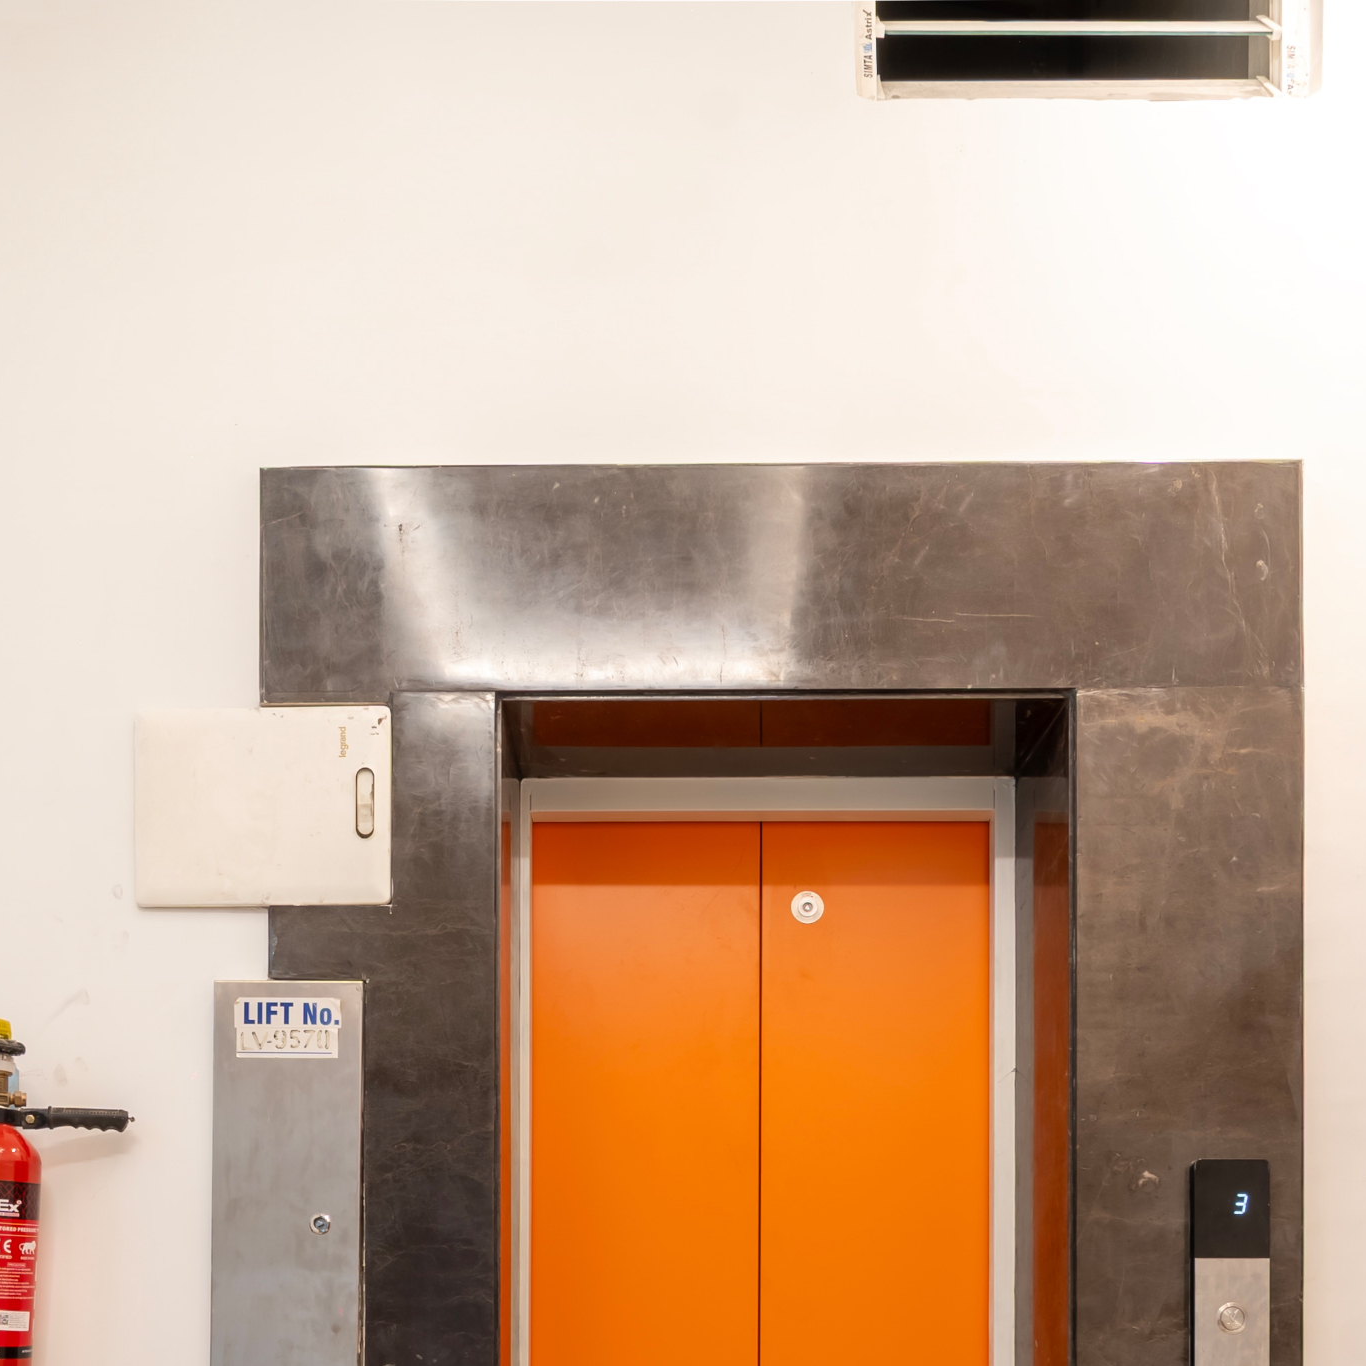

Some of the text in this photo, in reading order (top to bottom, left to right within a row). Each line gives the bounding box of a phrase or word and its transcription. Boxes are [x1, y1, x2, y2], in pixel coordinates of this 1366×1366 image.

[862, 9, 873, 78] SIMTA Astrix
[338, 726, 349, 758] legrand
[243, 1001, 340, 1026] LIFT No.
[1233, 1193, 1249, 1215] 3
